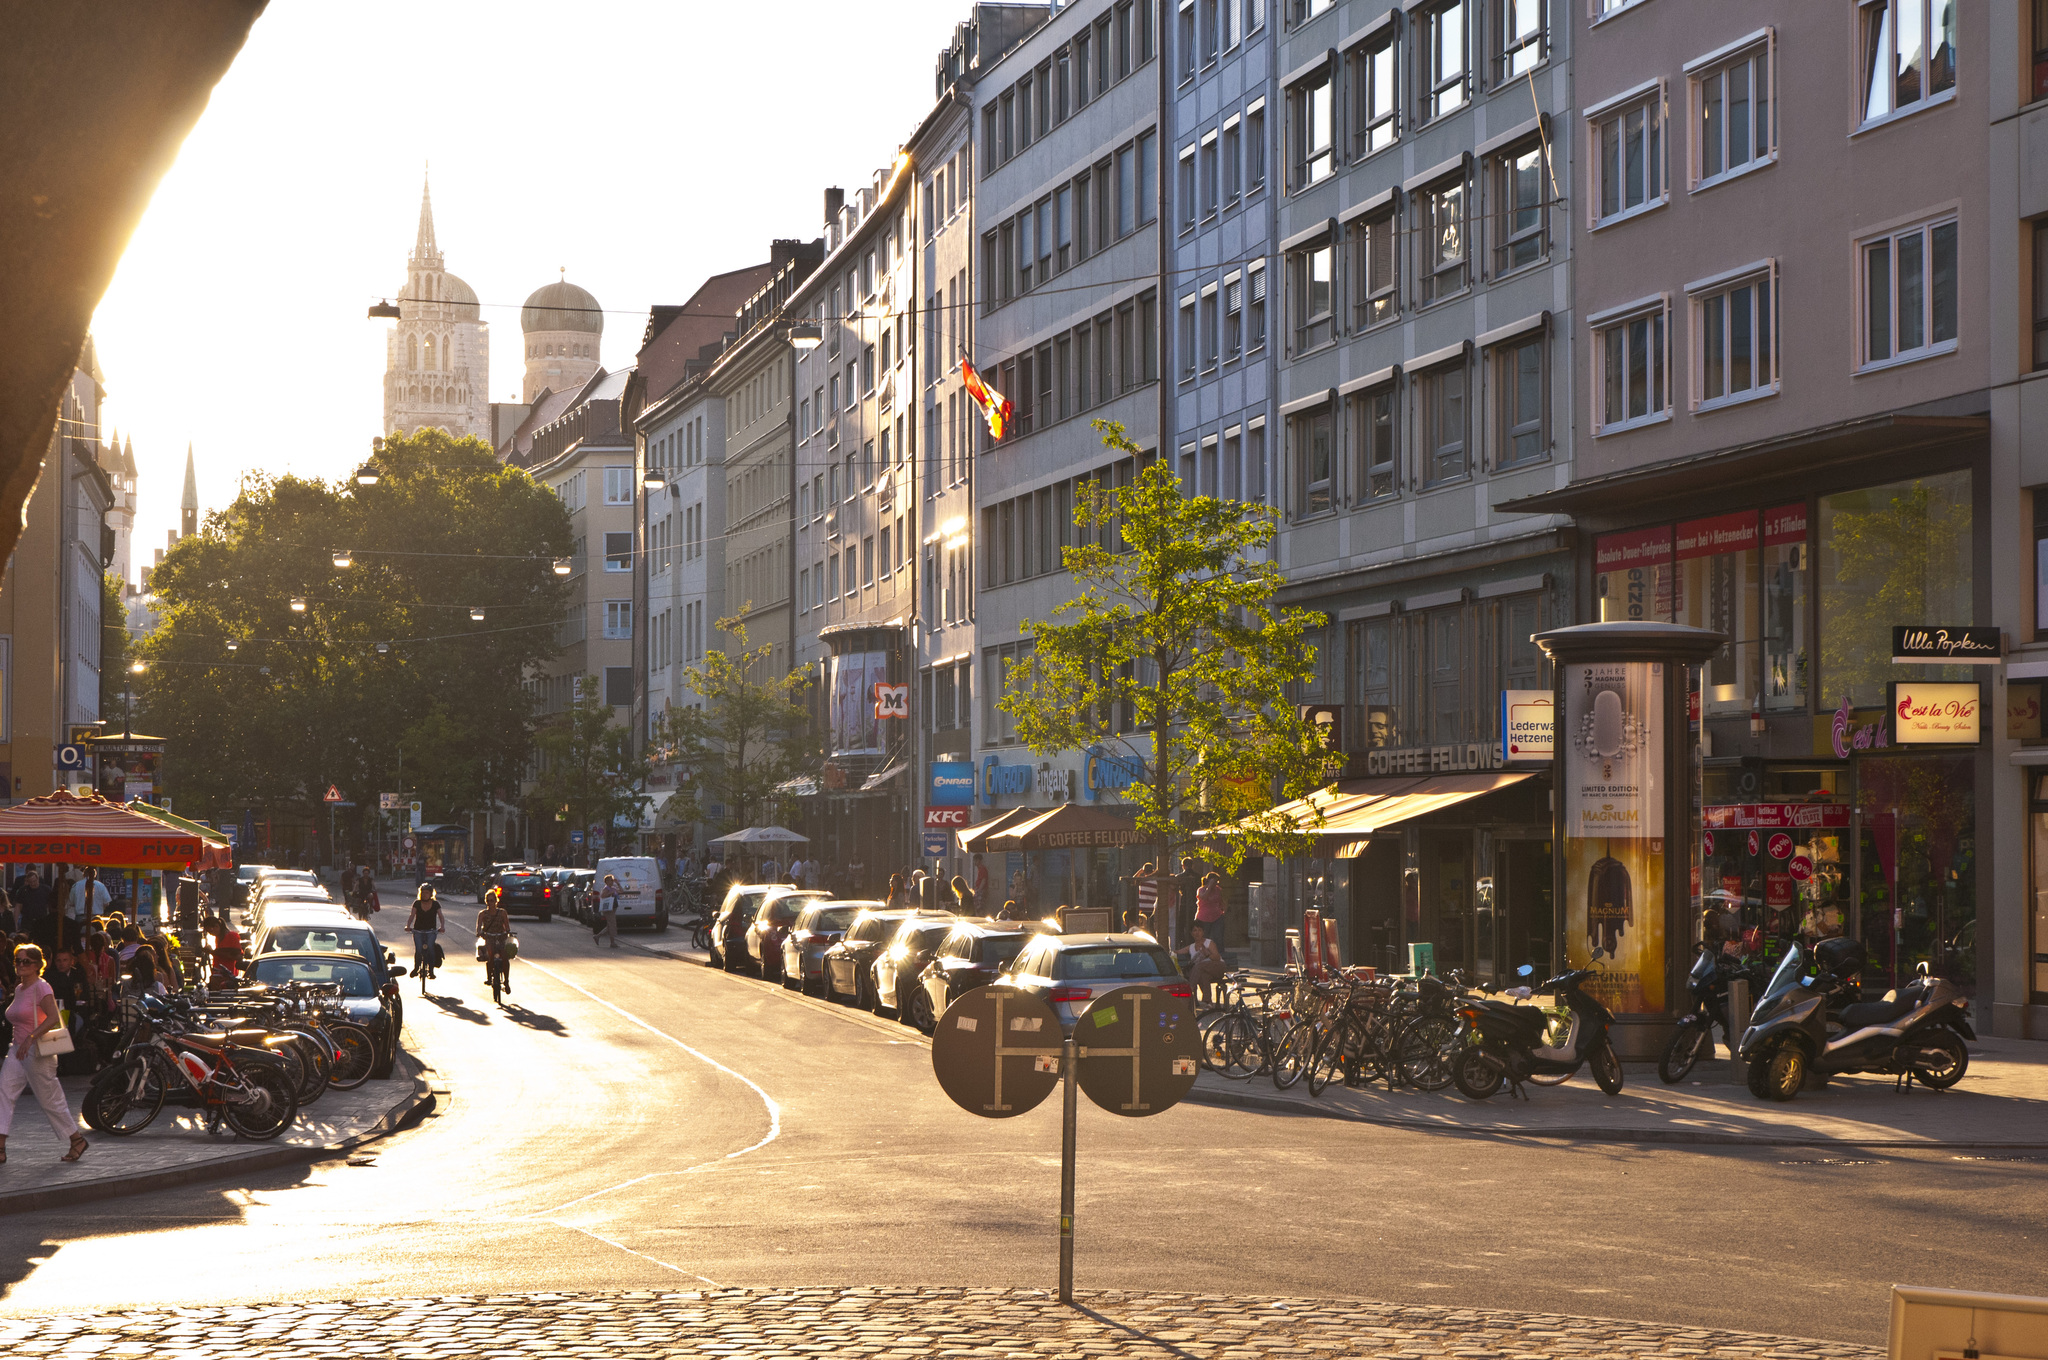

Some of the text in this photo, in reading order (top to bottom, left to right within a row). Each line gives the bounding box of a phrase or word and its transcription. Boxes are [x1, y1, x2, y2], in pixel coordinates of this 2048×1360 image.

[1597, 515, 1806, 564] Absolute Dauer-Tiefpreise immer bei Hetzenecker in 5 Filialen
[1627, 568, 1644, 622] etze
[1902, 629, 1996, 656] Ulla Popken
[1595, 667, 1626, 676] JAHRE
[884, 693, 903, 709] M
[1897, 694, 1929, 720] C'est
[1929, 703, 1943, 717] la
[1510, 733, 1554, 744] Hetzene
[1368, 748, 1425, 775] COFFEE
[1430, 742, 1504, 772] FELLOWS
[934, 776, 973, 788] CONRAD
[983, 745, 1145, 805] CONRAD Eingang CONRAD
[926, 810, 965, 823] KFC
[1582, 809, 1639, 822] MAGNUM
[1050, 832, 1091, 847] COFFEE
[1094, 830, 1147, 844] FELLOWS
[1771, 838, 1790, 855] 70%
[142, 840, 194, 856] riva
[1790, 862, 1811, 876] 60%
[1590, 906, 1629, 915] MAGNUM
[1588, 973, 1640, 982] AGNUM
